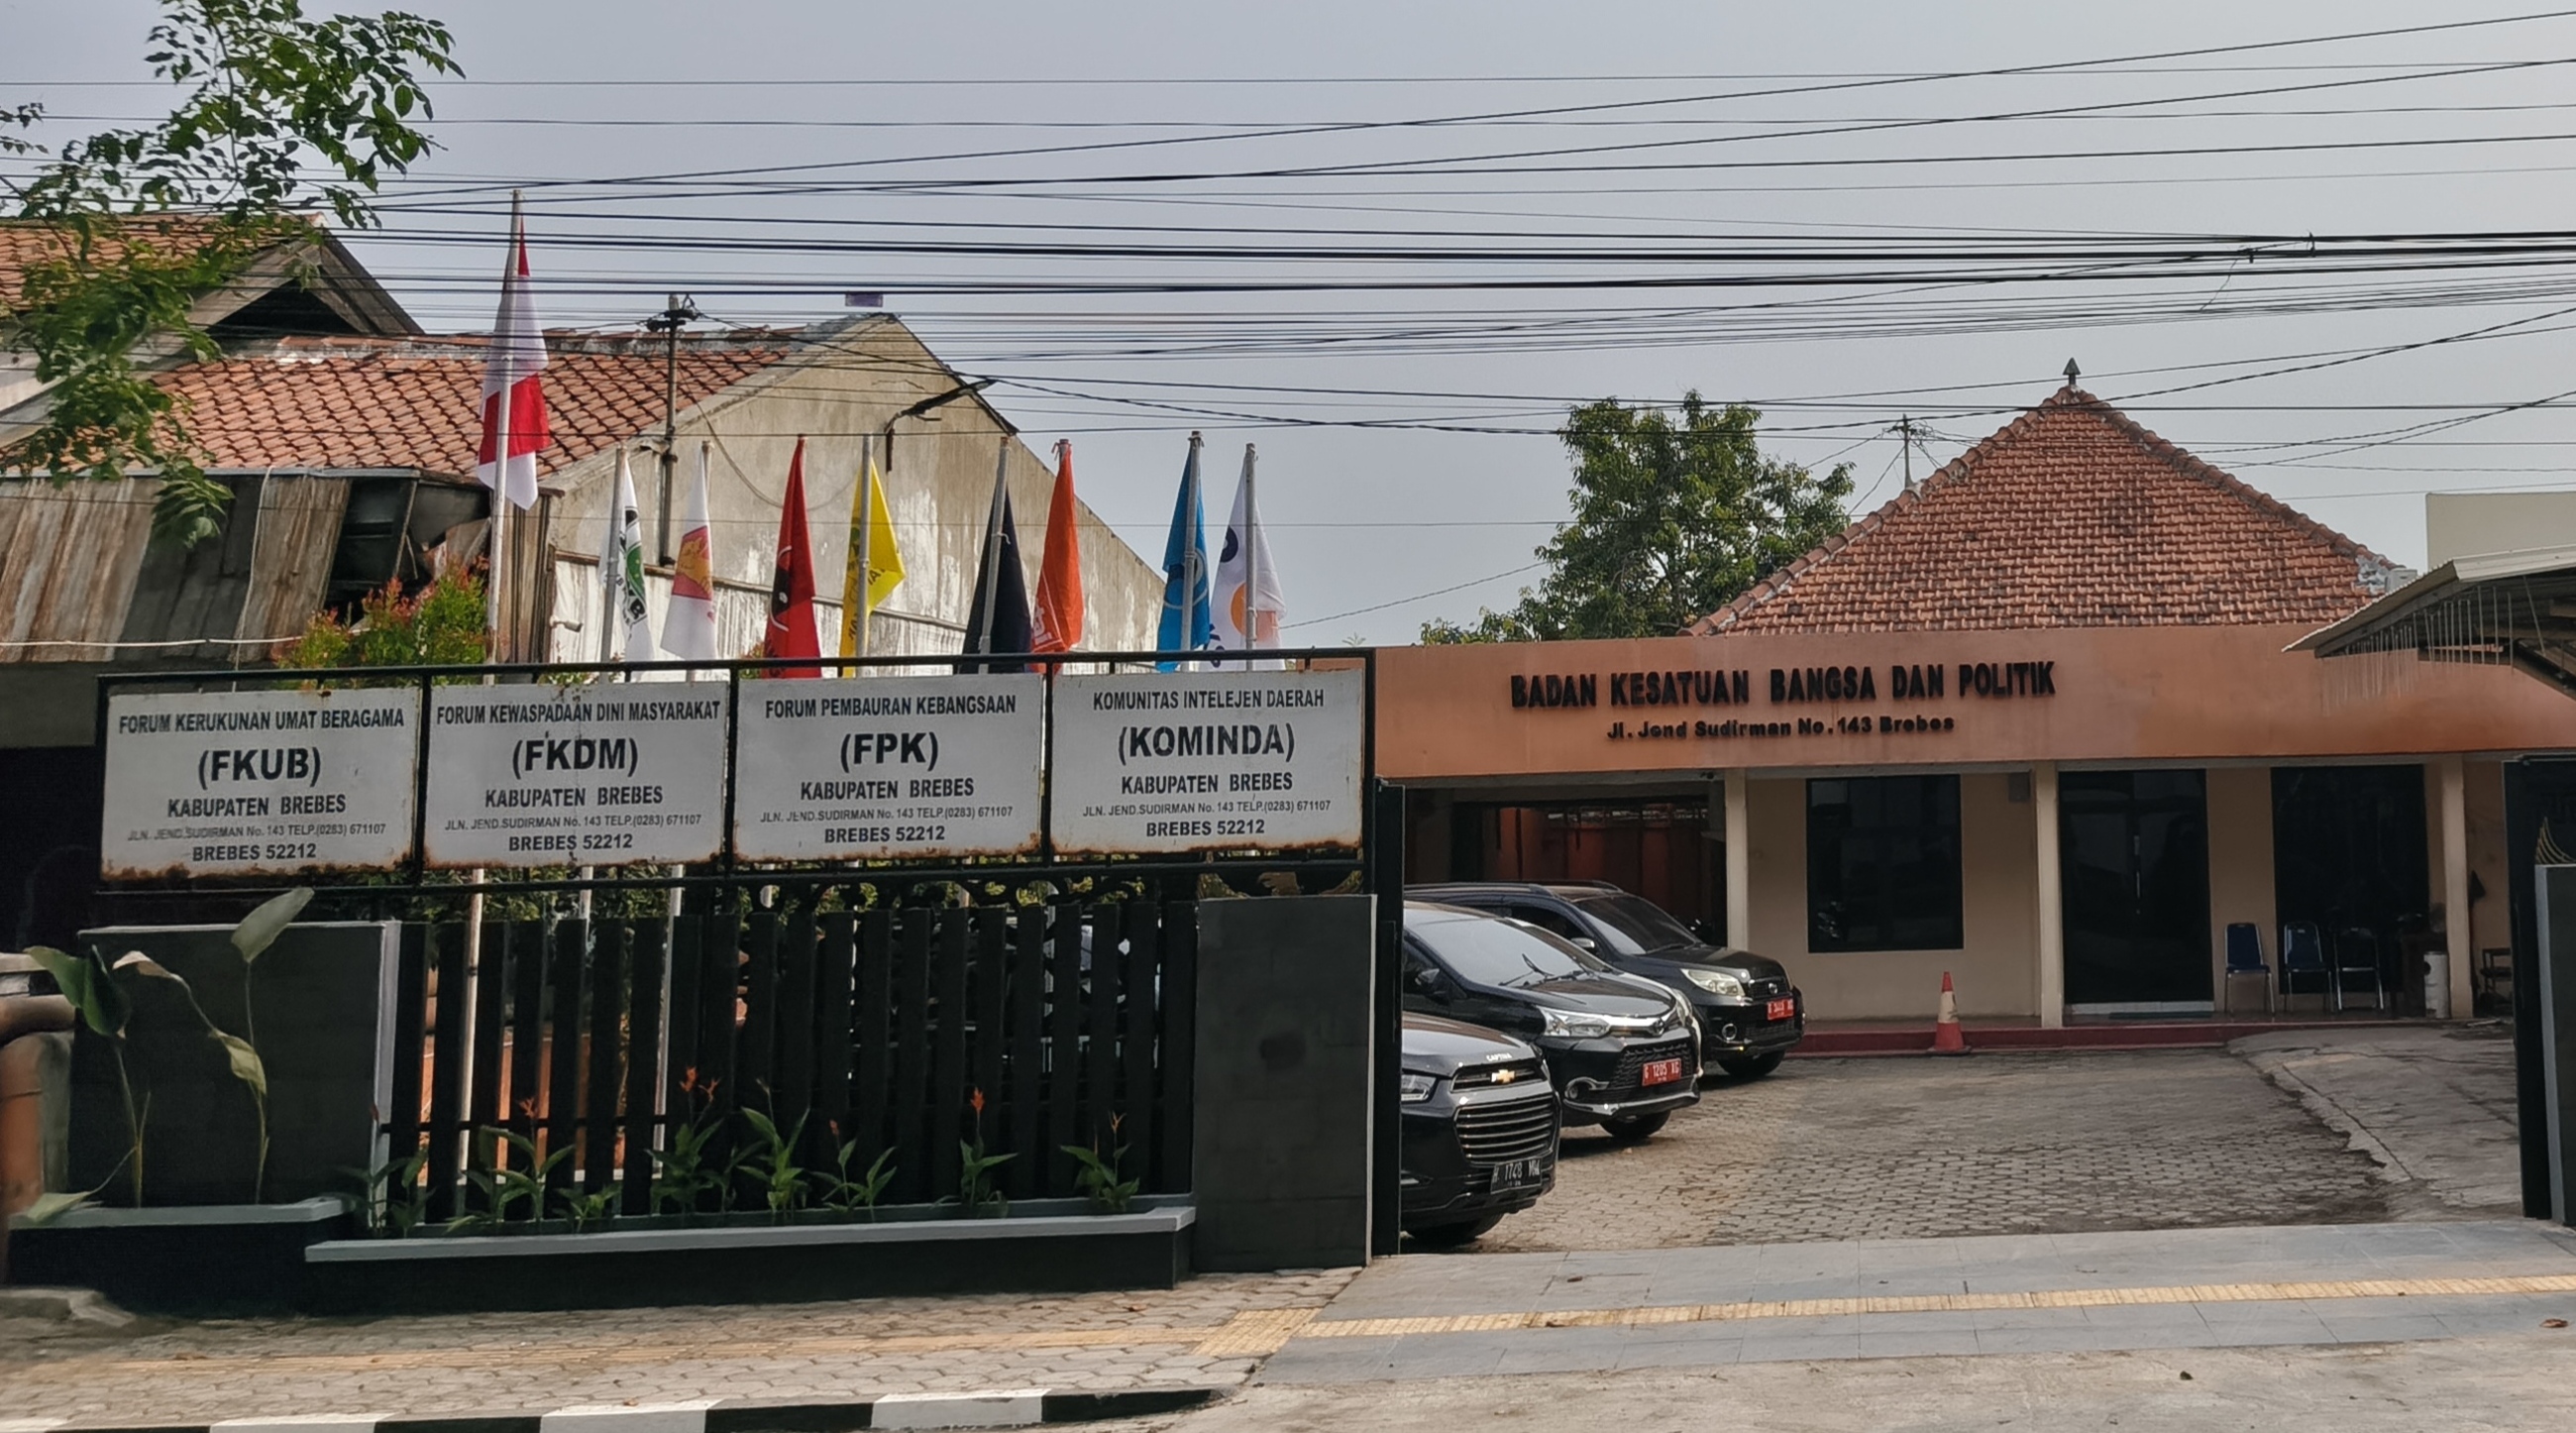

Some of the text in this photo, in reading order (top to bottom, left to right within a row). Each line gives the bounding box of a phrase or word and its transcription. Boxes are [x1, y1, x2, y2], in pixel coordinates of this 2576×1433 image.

[1510, 661, 2056, 709] BADAN KESATUAN BANGSA DAN POLITIK
[765, 695, 1016, 718] FORUM PEMBAURAN KEBANGSAAN
[1093, 689, 1324, 711] KOMUNITAS INTELEJEN DAERAH
[119, 709, 404, 734] FORUM KERUKUNAN UMAT BERAGAMA
[437, 701, 720, 724] FORUM KEWASPADAAN DINI MASYARAKAT
[1607, 721, 1633, 738] Jl.
[1694, 719, 1791, 737] Sudirman
[1879, 715, 1954, 733] Brebes
[840, 731, 938, 774] (FPK)
[1118, 722, 1295, 766] (KOMINDA)
[199, 746, 321, 790] (FKUB)
[512, 737, 638, 780] (FKDM)
[801, 778, 974, 801] KABUPATEN BREBES
[1122, 772, 1293, 795] KABUPATEN BREBES
[167, 794, 346, 818] KABUPATEN BREBES
[485, 786, 663, 808] KABUPATEN BREBES
[1083, 805, 1106, 817] JLN.
[1197, 802, 1215, 814] No.
[1217, 801, 1234, 813] 143
[1297, 800, 1331, 812] 671107
[445, 820, 469, 830] JLN.
[563, 817, 581, 827] No.
[585, 816, 601, 827] 143
[666, 815, 701, 826] 671107
[760, 812, 784, 824] JLN.
[877, 808, 894, 820] No.
[897, 808, 913, 819] 143
[978, 806, 1013, 818] 671107
[247, 826, 264, 837] No.
[268, 825, 285, 837] 143
[350, 824, 386, 834] 671107
[824, 826, 945, 844] BREBES 52212
[1145, 819, 1265, 837] BREBES 52212
[192, 843, 316, 862] BREBES 52212
[509, 833, 633, 852] BREBES 52212
